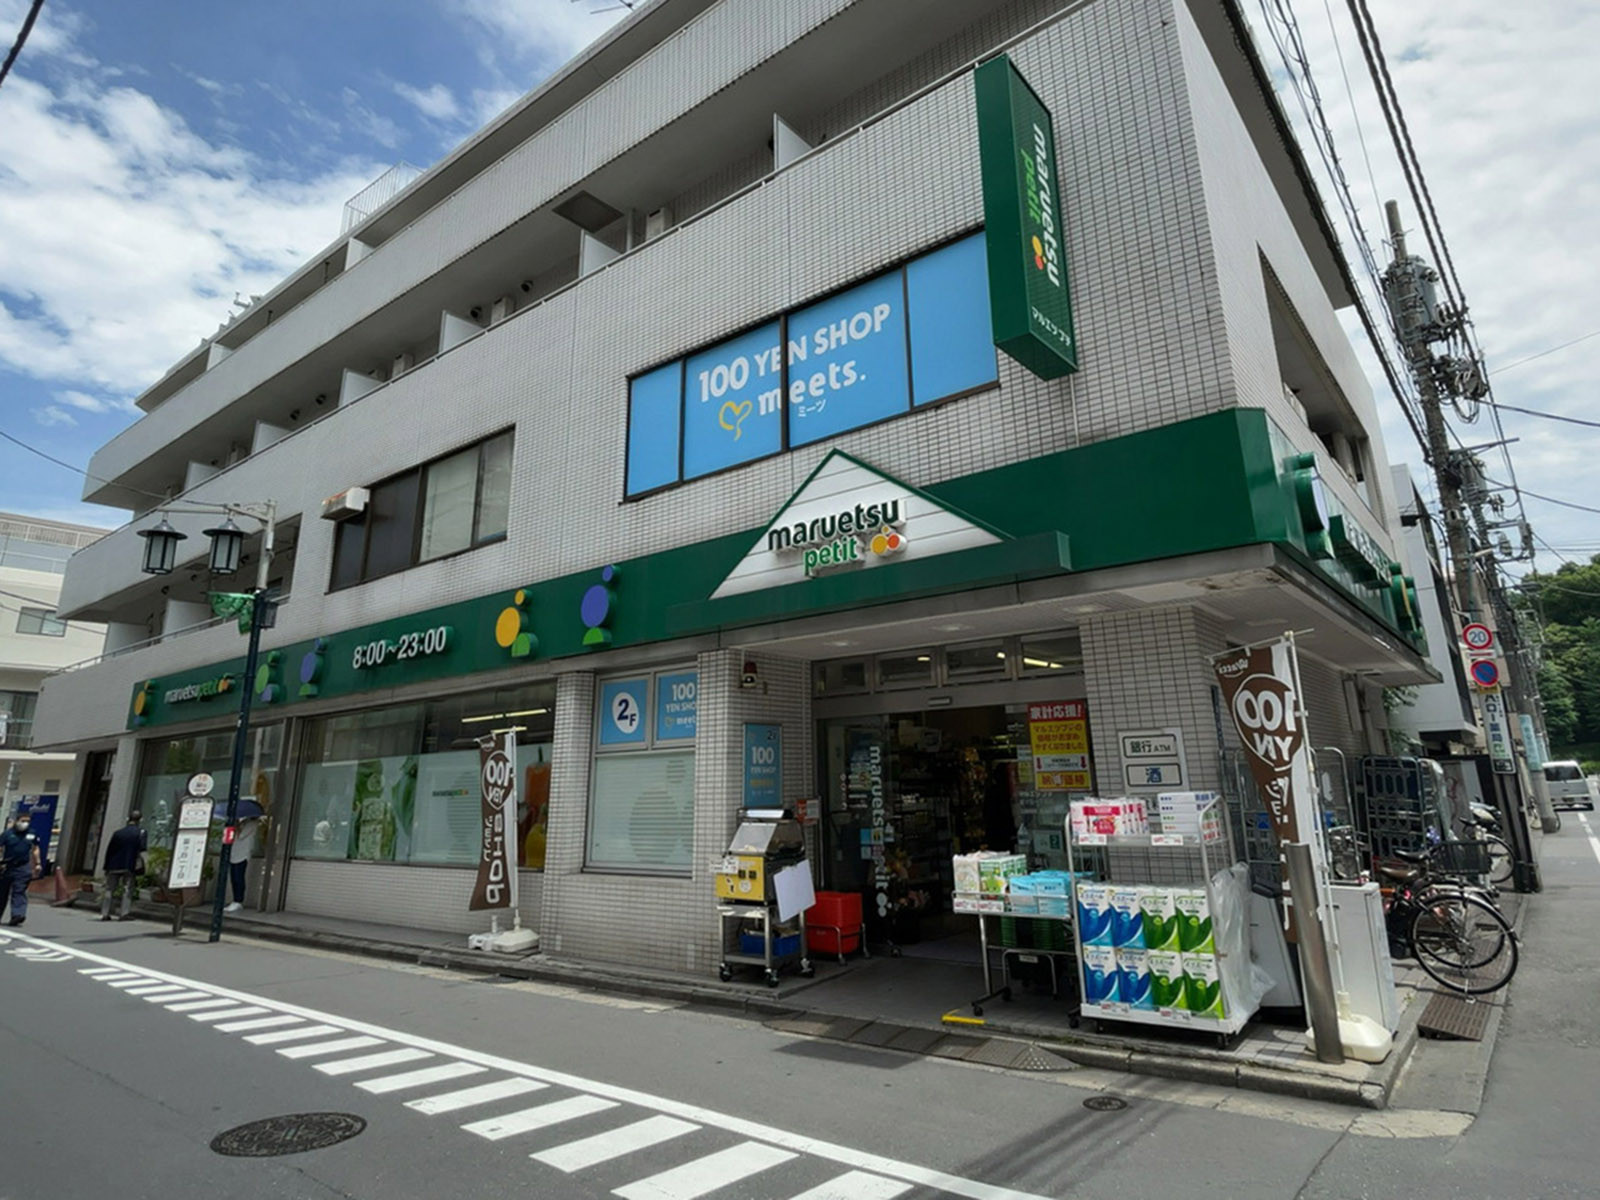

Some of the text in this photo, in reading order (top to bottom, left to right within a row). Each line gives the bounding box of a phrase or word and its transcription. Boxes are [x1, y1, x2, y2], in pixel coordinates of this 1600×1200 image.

[1021, 148, 1041, 225] petit
[1033, 123, 1060, 288] maruetsu
[699, 303, 891, 402] 100 YEN SHOP
[758, 360, 866, 416] meets.
[798, 399, 827, 418] ミーツ
[768, 500, 899, 550] maruetsu
[804, 536, 858, 576] petit
[1469, 631, 1487, 644] 20
[672, 682, 696, 701] 100
[617, 698, 637, 727] 2F
[681, 700, 697, 712] SHO
[676, 715, 697, 725] meet
[751, 747, 775, 765] 100
[1145, 767, 1162, 784] 酒
